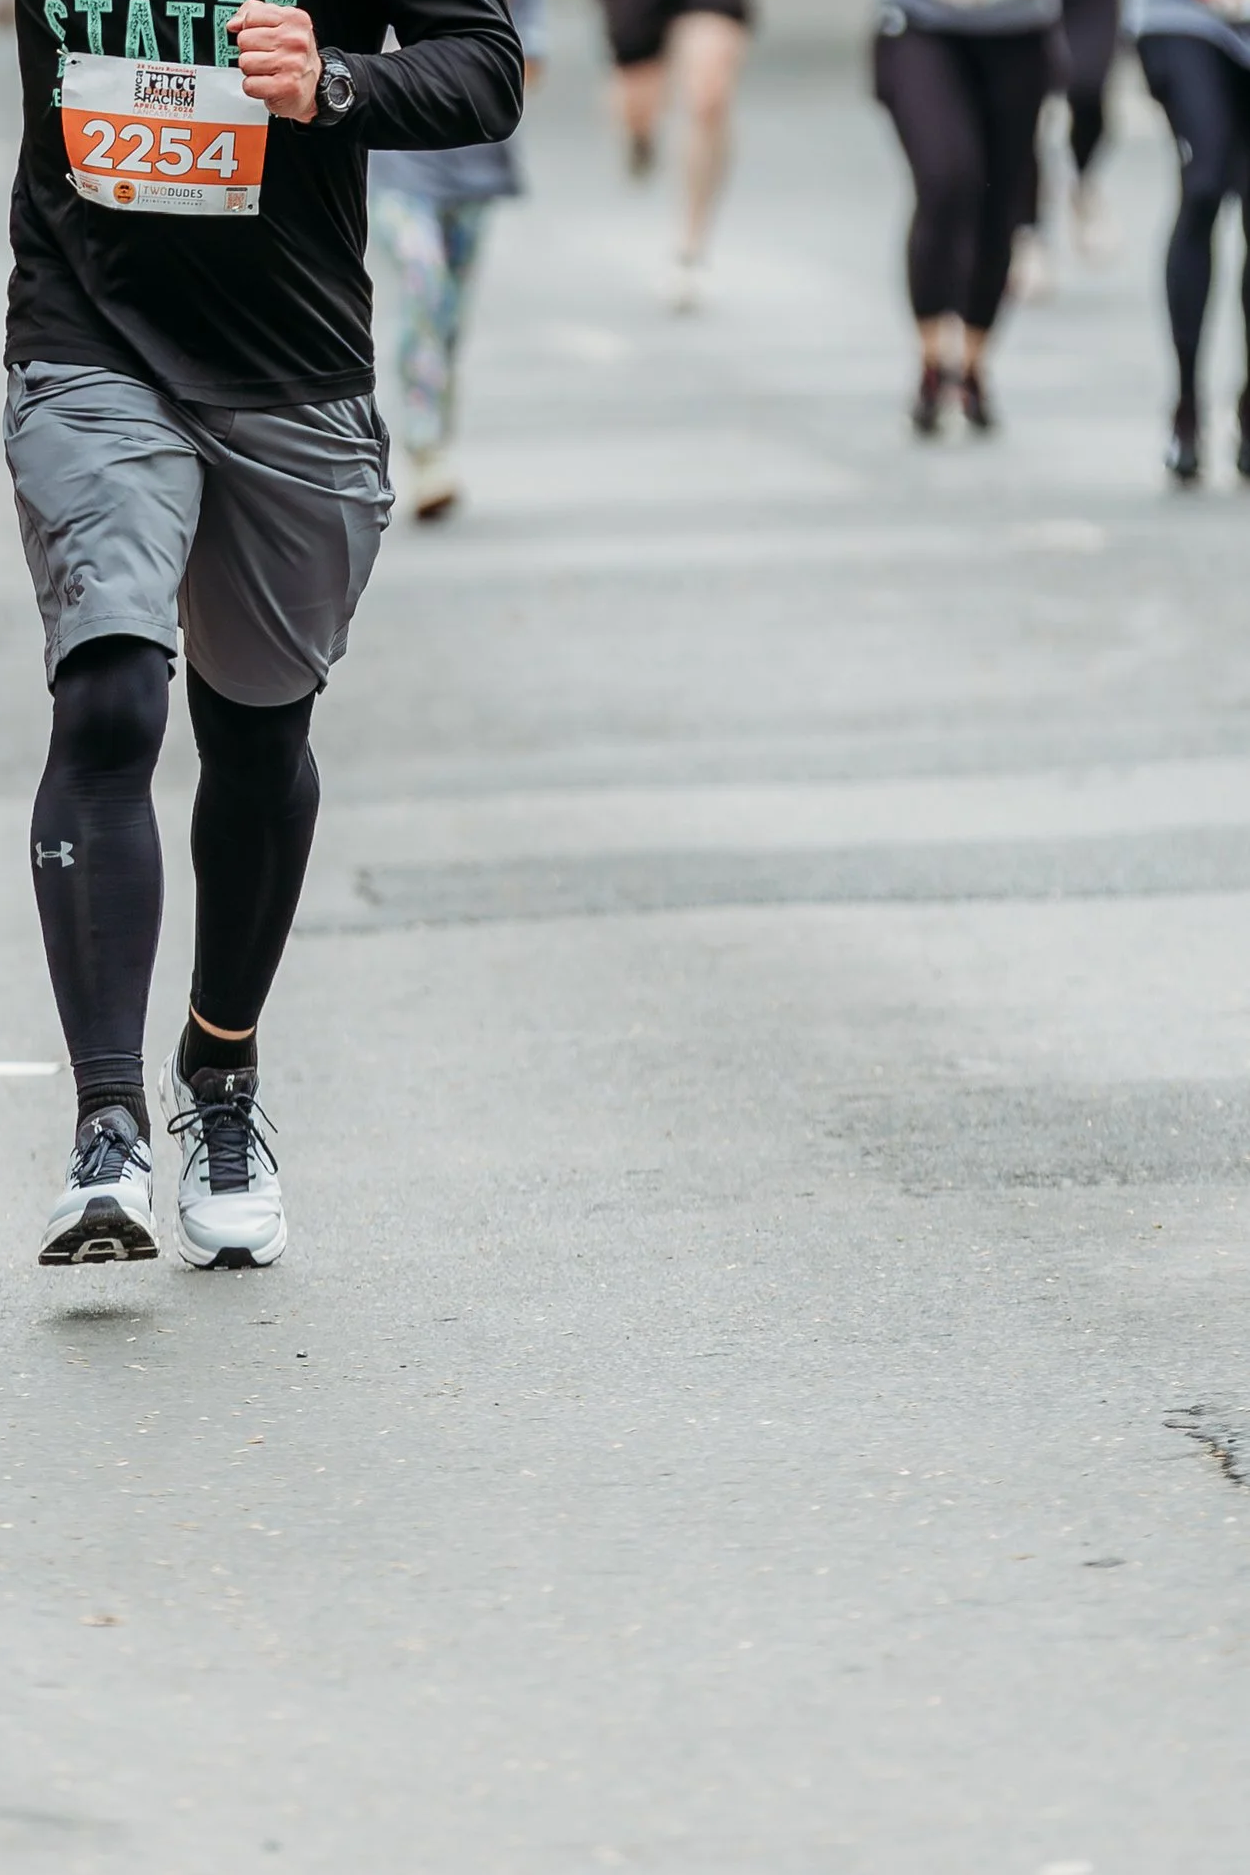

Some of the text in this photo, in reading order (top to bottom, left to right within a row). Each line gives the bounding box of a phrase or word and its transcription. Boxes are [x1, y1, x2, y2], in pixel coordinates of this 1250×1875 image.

[134, 70, 145, 102] ywca
[145, 71, 196, 91] race
[134, 102, 156, 110] APRIL
[144, 93, 195, 107] RACISM
[81, 119, 239, 178] 2254
